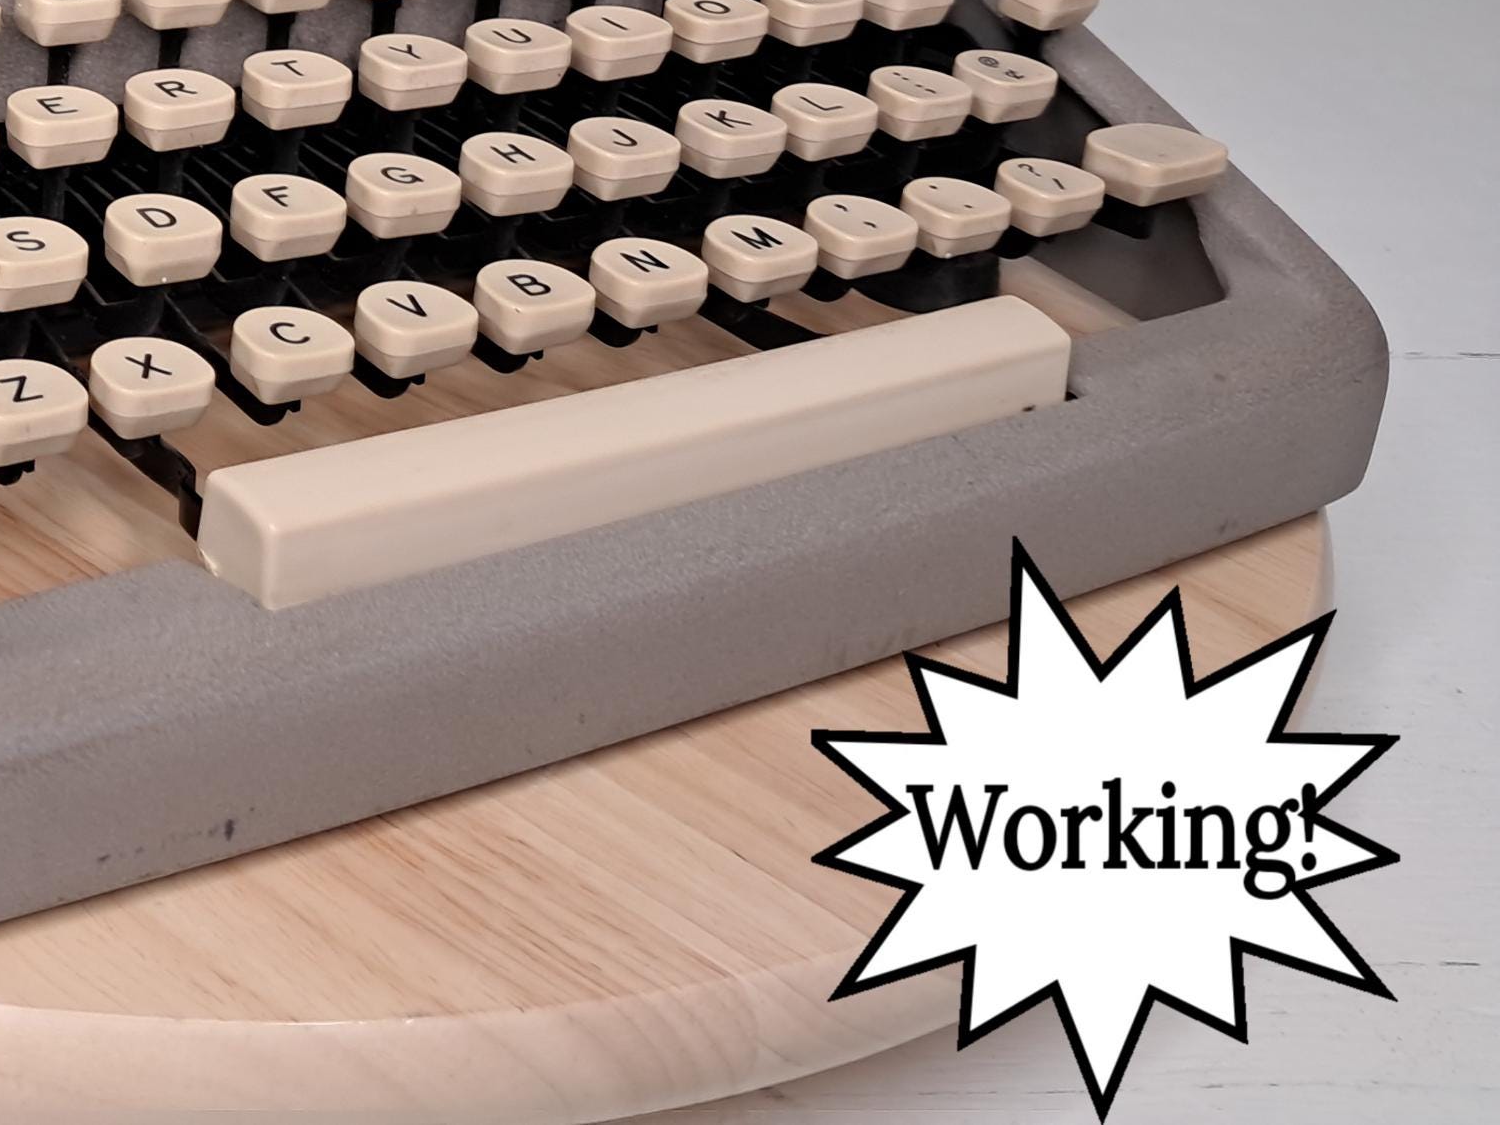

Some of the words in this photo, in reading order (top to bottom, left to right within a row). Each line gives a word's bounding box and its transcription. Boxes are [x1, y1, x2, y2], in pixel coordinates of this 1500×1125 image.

[694, 0, 731, 14] O
[492, 29, 532, 43] U
[388, 44, 421, 59] Y
[271, 60, 304, 76] T
[155, 81, 197, 98] R
[37, 97, 78, 114] E
[800, 97, 843, 111] L
[705, 110, 752, 128] K
[612, 129, 637, 147] J
[490, 144, 536, 163] H
[381, 167, 424, 184] G
[262, 186, 288, 207] F
[136, 208, 177, 228] D
[7, 231, 45, 251] S
[731, 227, 783, 249] M
[620, 250, 670, 272] N
[507, 274, 551, 296] B
[386, 294, 427, 317] V
[270, 322, 310, 344] C
[125, 354, 172, 379] X
